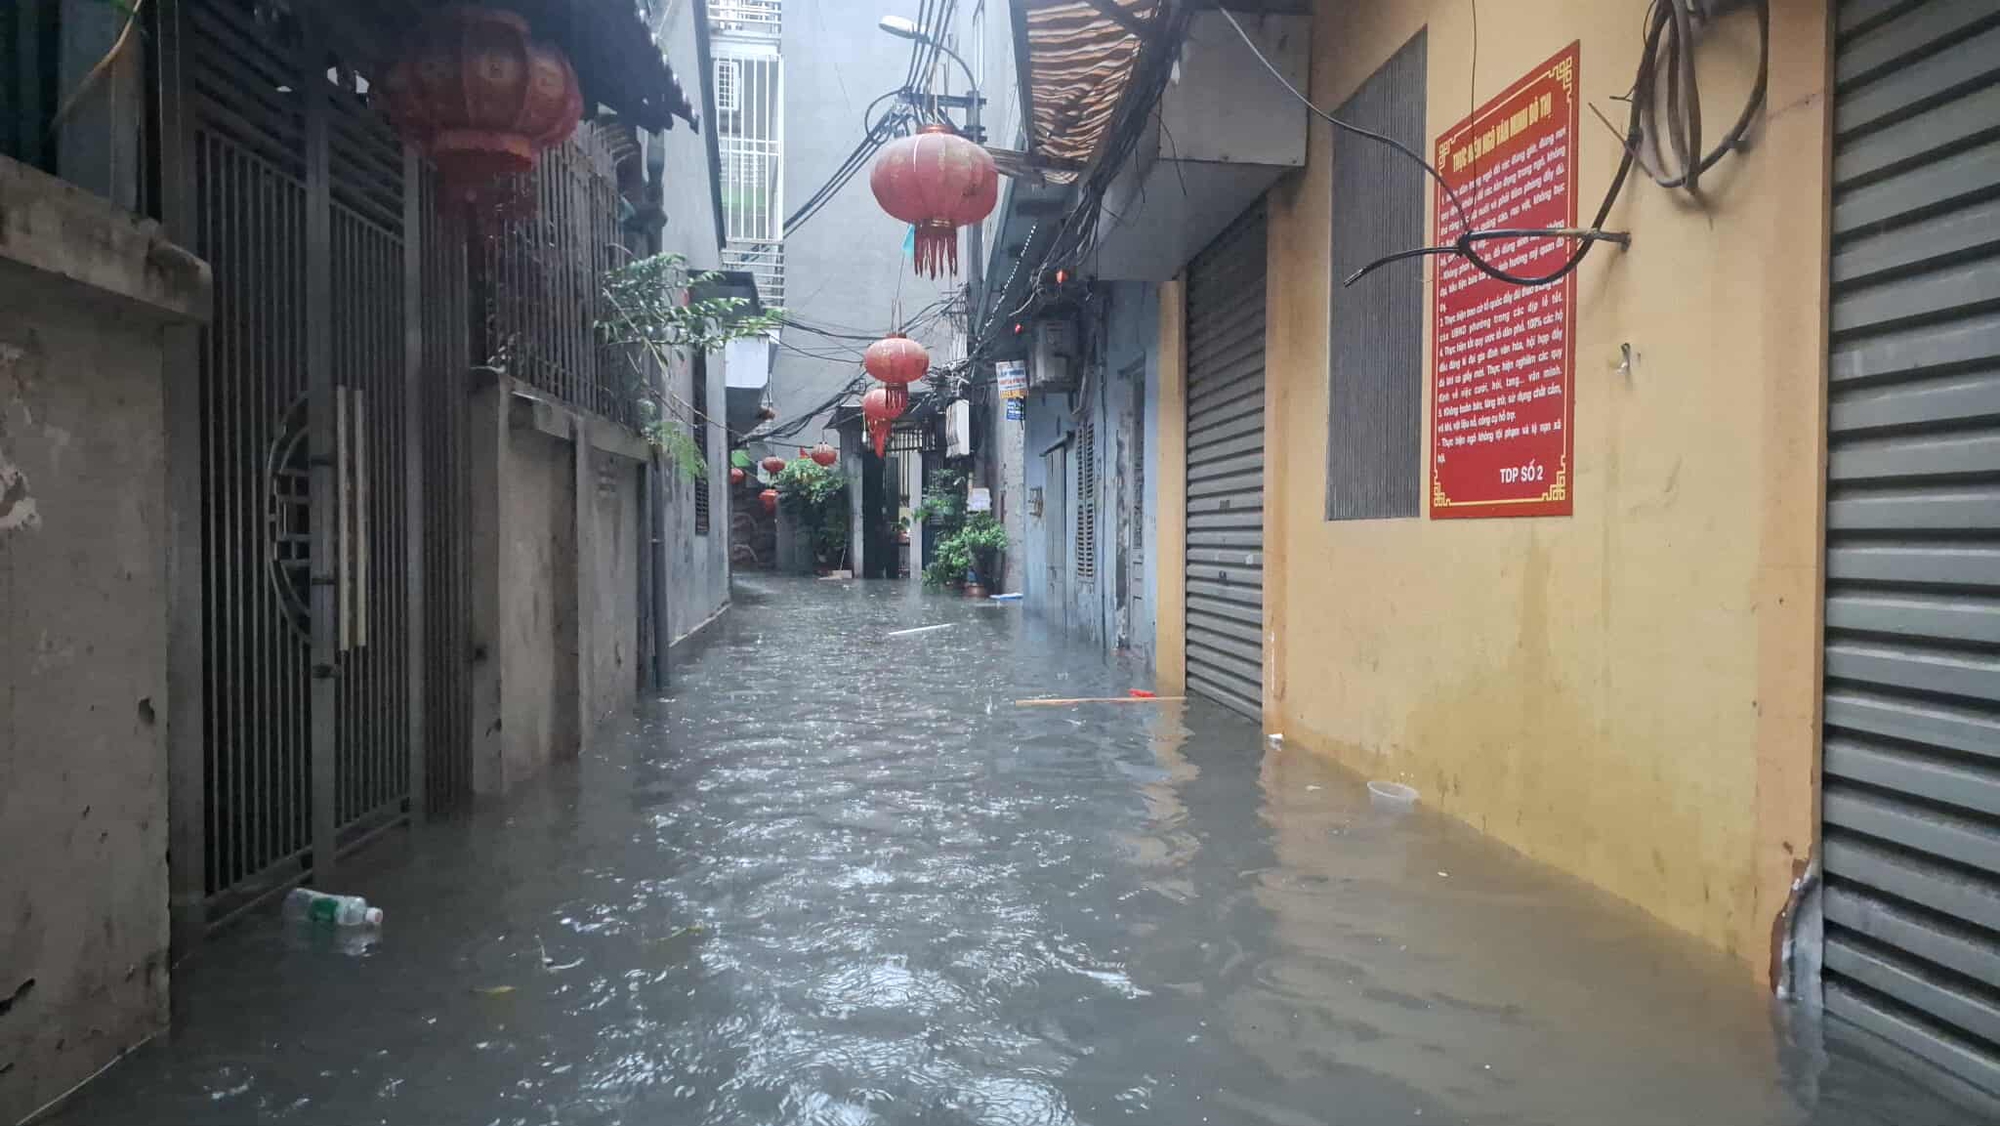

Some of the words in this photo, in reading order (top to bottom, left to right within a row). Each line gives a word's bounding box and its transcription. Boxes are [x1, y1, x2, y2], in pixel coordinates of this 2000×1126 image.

[1500, 467, 1519, 483] TDP
[1521, 459, 1535, 482] SỐ
[1537, 465, 1543, 480] 2
